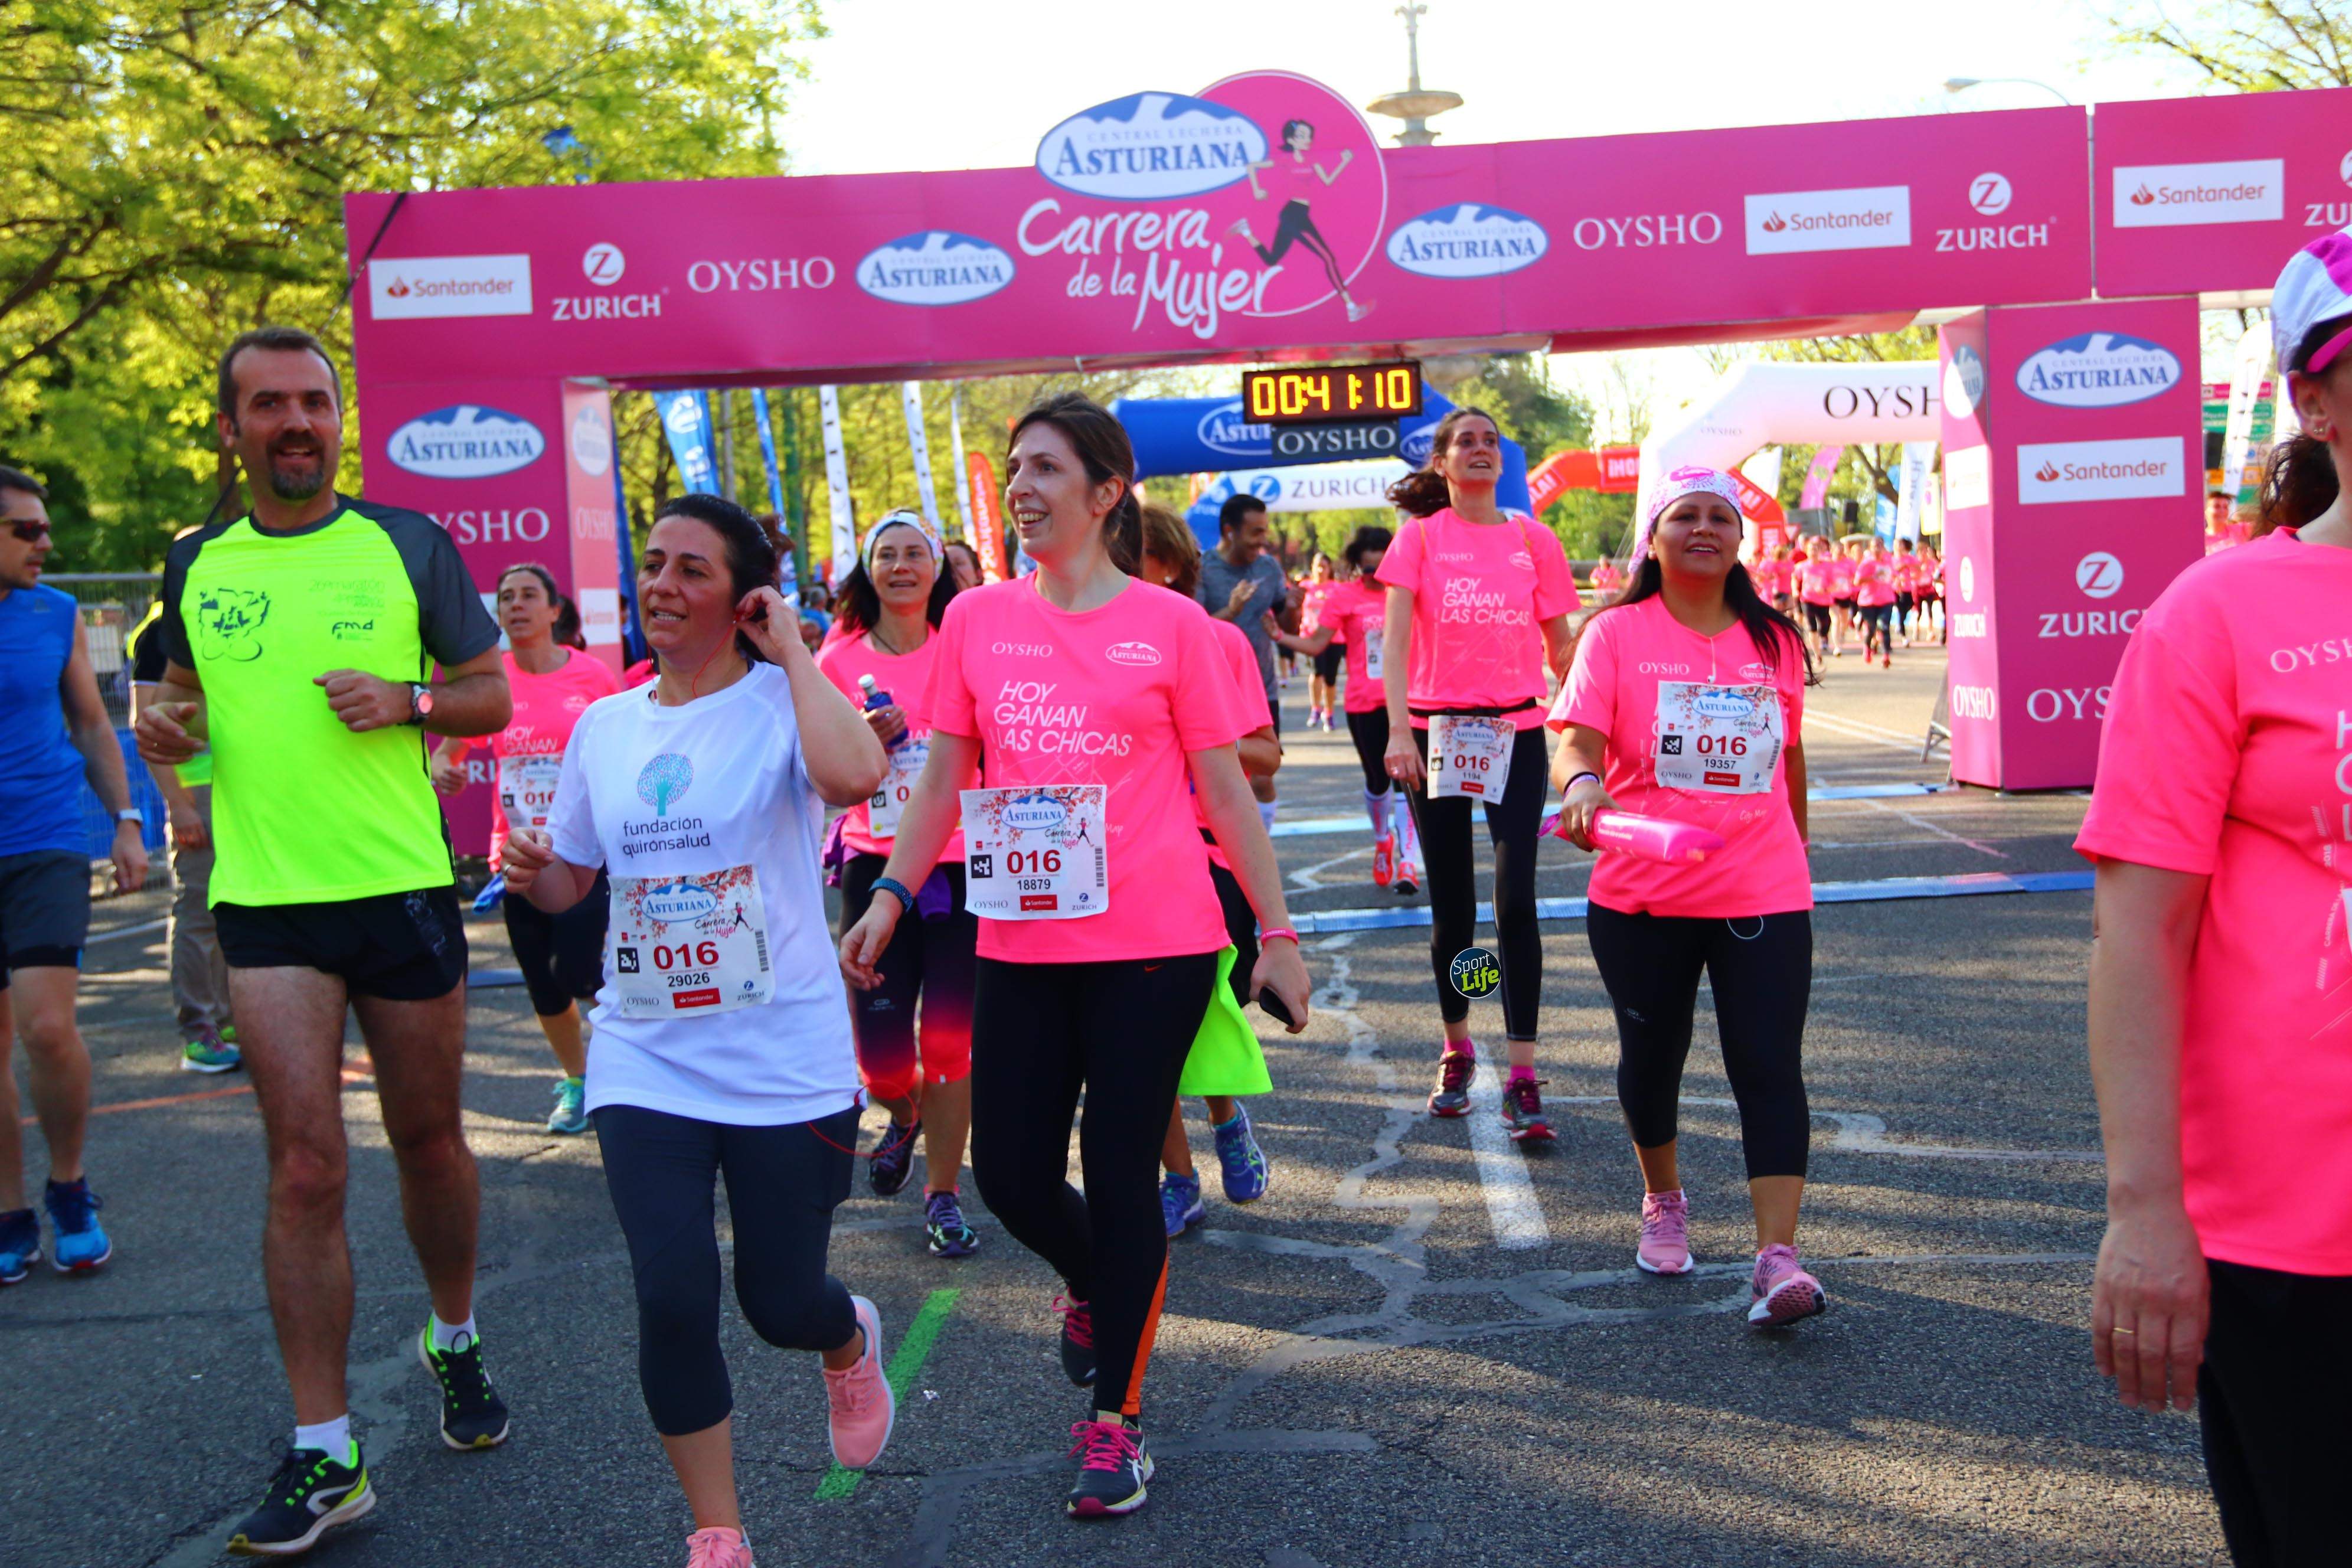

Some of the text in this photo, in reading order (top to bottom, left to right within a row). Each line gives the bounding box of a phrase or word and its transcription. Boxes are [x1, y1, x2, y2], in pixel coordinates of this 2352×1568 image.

[1087, 126, 1243, 142] CENTRAL LECHERA
[1054, 136, 1249, 177] ASTURIANA
[2158, 184, 2265, 205] Santander
[1017, 198, 1209, 256] Carrera
[1790, 210, 1893, 231] Santander
[1573, 212, 1723, 250] OYSHO
[1935, 225, 2048, 252] ZURICH
[1399, 234, 1537, 262] ASTURIANA
[687, 256, 835, 293] OYSHO
[868, 260, 1002, 288] ASTURIANA
[415, 279, 514, 296] Santander
[1067, 243, 1284, 339] de la Mujer
[553, 295, 661, 321] ZURICH
[2027, 362, 2169, 391] ASTURIANA
[1252, 369, 1411, 416] 00:41:10
[401, 435, 533, 462] ASTURIANA
[1278, 425, 1396, 456] OYSHO
[2064, 460, 2167, 481] Santander
[1291, 476, 1387, 499] ZURICH
[1435, 552, 1474, 561] OYSHO
[1445, 577, 1481, 593] HOY
[1442, 592, 1505, 607] GANAN
[1441, 609, 1530, 626] LAS CHICAS
[1953, 612, 1987, 638] ZURICH
[2039, 609, 2148, 638] ZURIC
[992, 642, 1053, 657] OYSHO
[1109, 649, 1157, 663] ASTURIANA
[1639, 661, 1690, 675] OYSHO
[999, 680, 1057, 703] HOY
[1697, 700, 1749, 713] ASTURIANA
[1952, 684, 1995, 721] OYSHO
[994, 703, 1087, 727] GANAN
[504, 726, 535, 738] HOY
[1455, 730, 1494, 739] ASTURIANA
[504, 738, 558, 754] GANAN
[999, 728, 1132, 756] LAS CHICAS
[1697, 734, 1747, 756] 016
[1454, 754, 1490, 771] 016
[1704, 758, 1736, 770] 19357
[1462, 772, 1481, 780] 1194
[1661, 770, 1692, 780] OYSHO
[1005, 809, 1062, 822] ASTURIANA
[623, 817, 702, 837] fundación
[1045, 828, 1071, 838] Carrera
[623, 833, 711, 858] quirónsalud
[1060, 837, 1079, 850] Mujer
[1007, 850, 1061, 874] 016
[1017, 878, 1051, 890] 18879
[646, 899, 712, 914] ASTURIANA
[974, 900, 1008, 909] OYSHO
[695, 917, 726, 929] Carrera
[715, 926, 737, 939] Mujer
[654, 941, 720, 970] 016
[667, 972, 710, 988] 29026
[627, 996, 659, 1007] OYSHO
[687, 994, 714, 1003] Santander
[737, 991, 765, 1001] ZURICH
